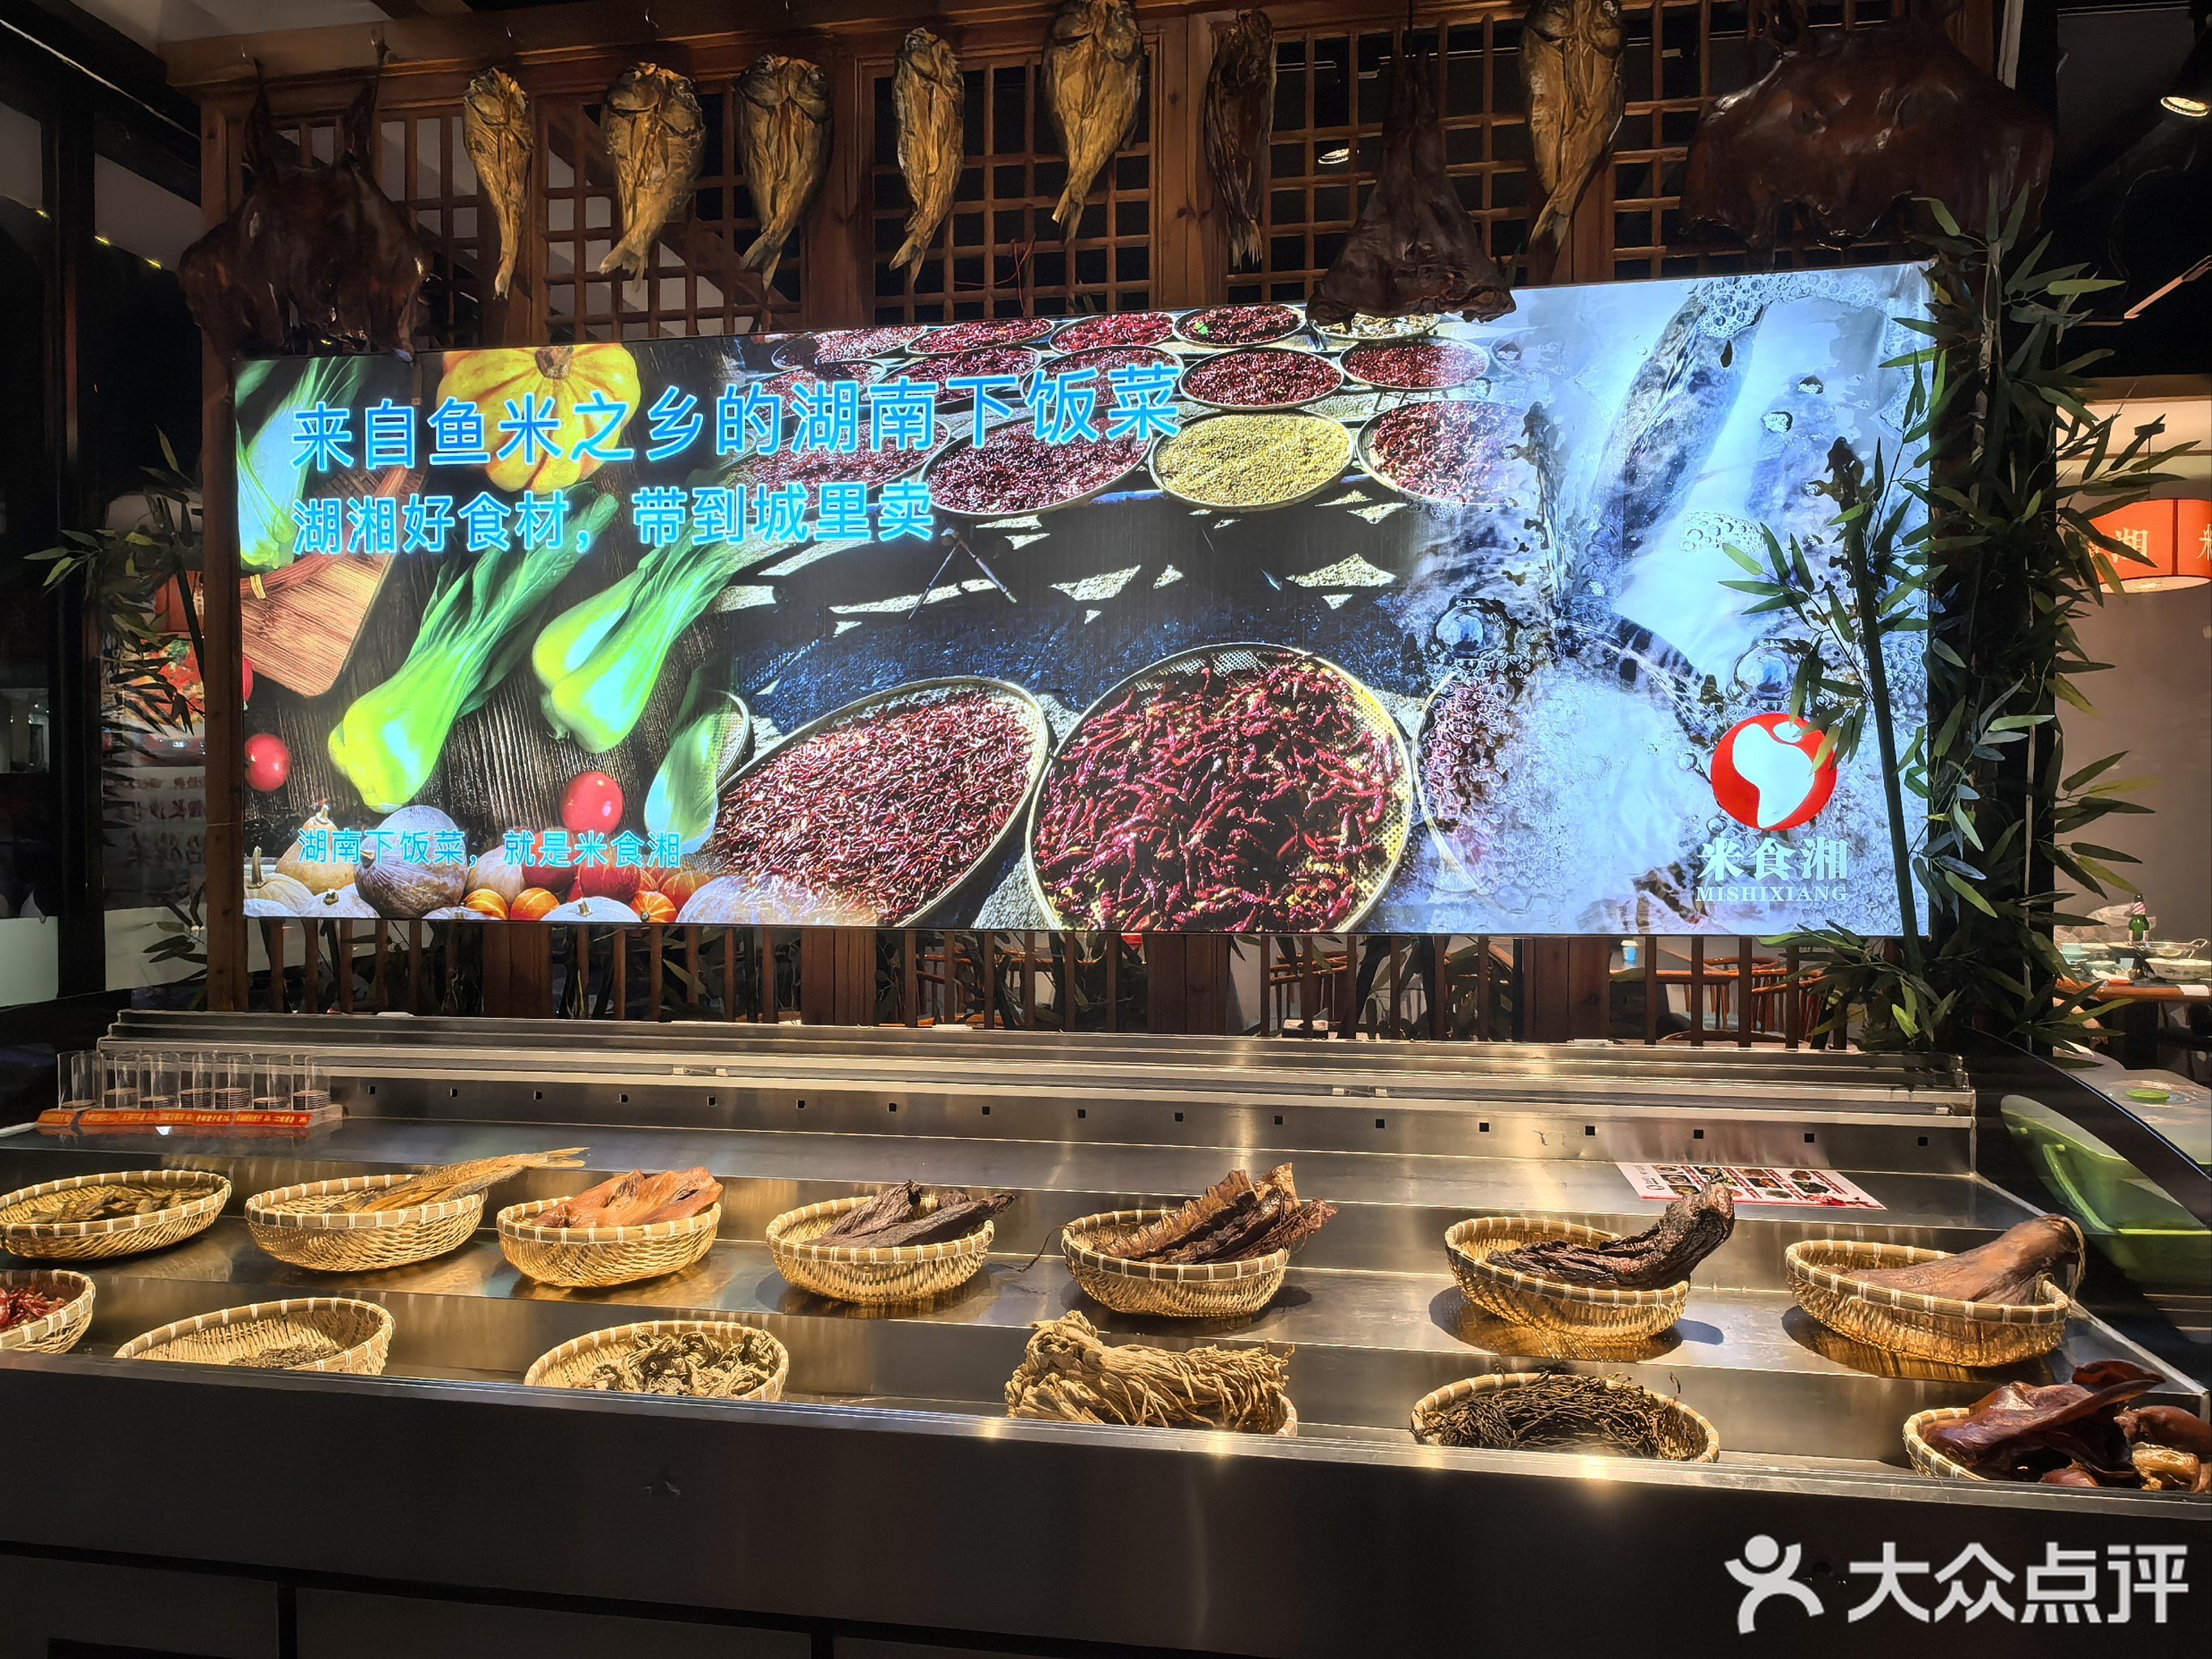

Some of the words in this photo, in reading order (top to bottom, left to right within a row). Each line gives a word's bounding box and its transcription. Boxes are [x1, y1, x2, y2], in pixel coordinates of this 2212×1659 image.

[290, 360, 1184, 472] 来自鱼米之乡的湖南下饭菜
[292, 489, 593, 556] 湖湘好食材，
[630, 481, 936, 548] 带到城里卖
[501, 829, 684, 869] 就是米食湘
[1697, 836, 1849, 881] 米食湘
[1695, 886, 1848, 902] MISHIXIANG
